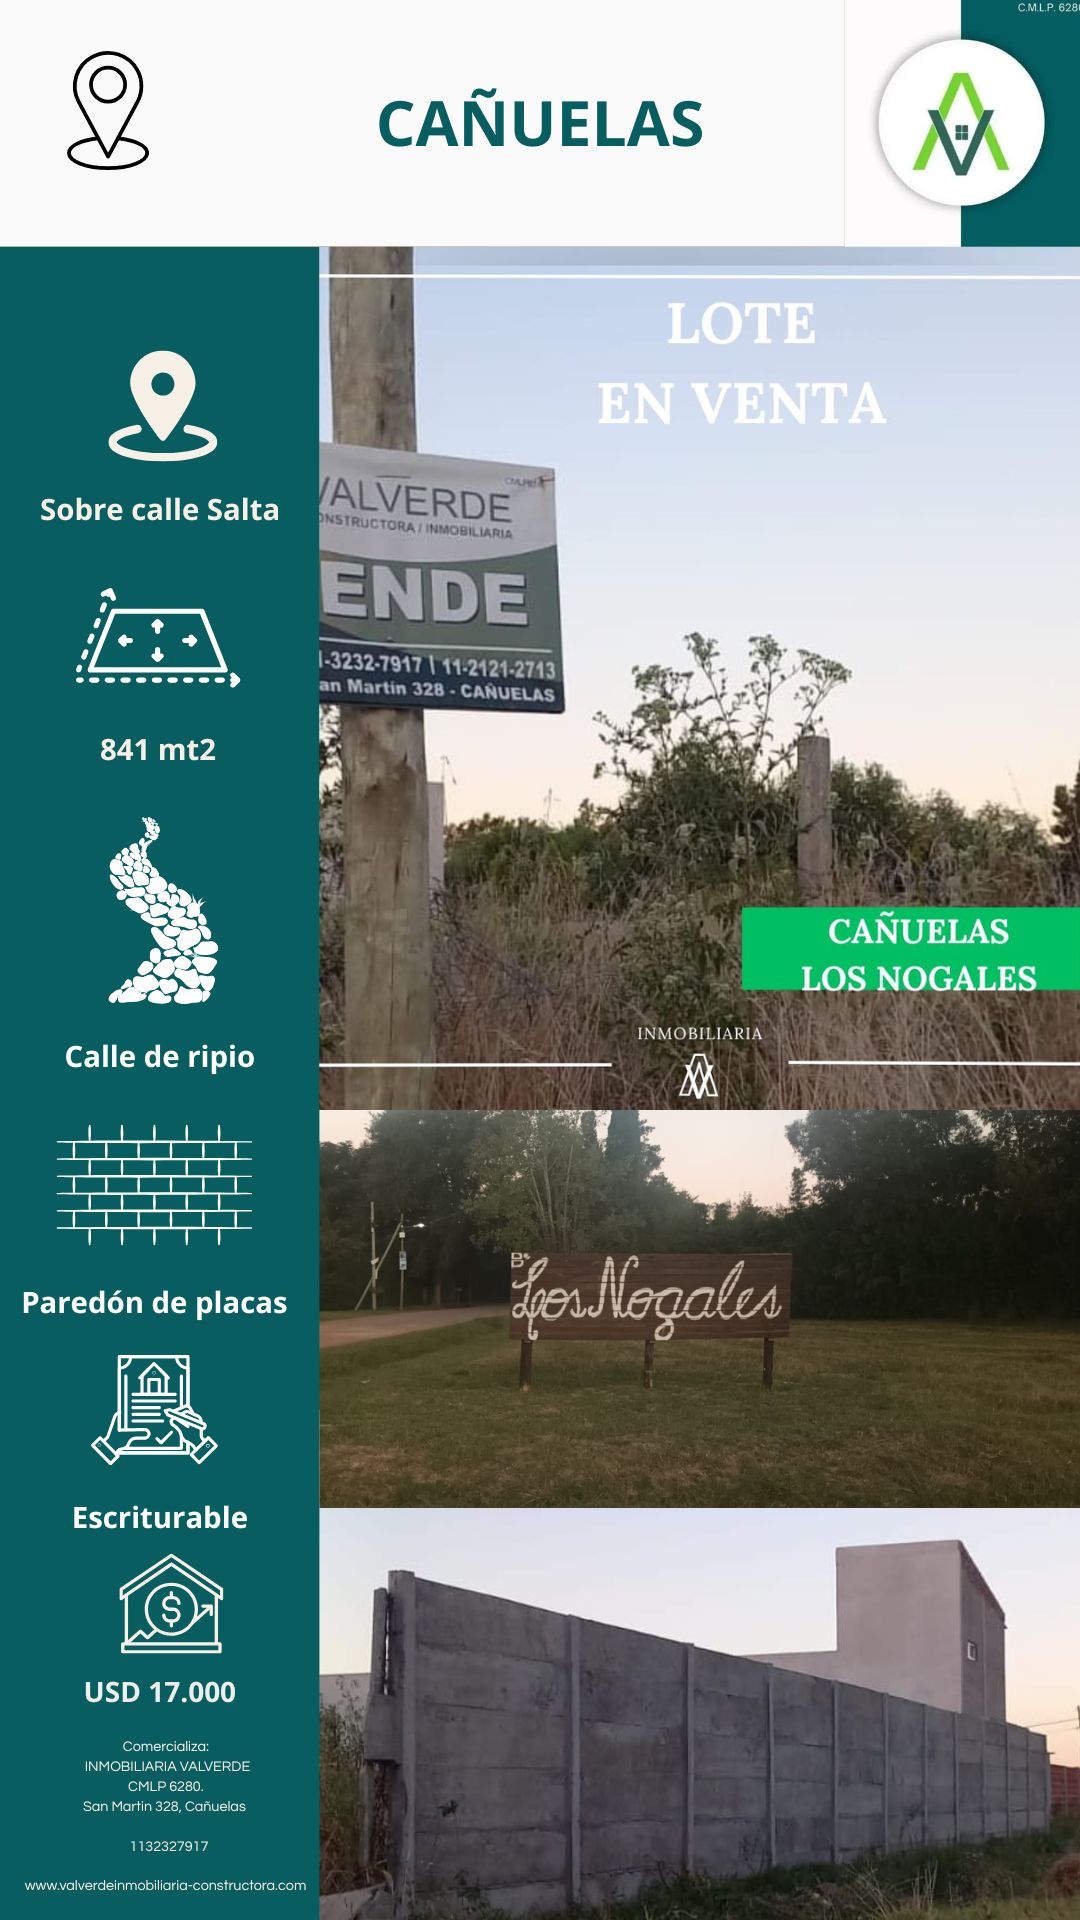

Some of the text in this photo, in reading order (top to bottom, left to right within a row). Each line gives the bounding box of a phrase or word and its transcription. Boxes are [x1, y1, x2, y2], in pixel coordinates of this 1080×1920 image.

[426, 523, 513, 540] INMOBILIARIA
[320, 560, 529, 626] ENDE
[442, 658, 556, 680] 11-2121-2713
[412, 681, 445, 698] 328
[460, 683, 556, 703] CAÑUELAS
[511, 1255, 782, 1341] Los Nogales
